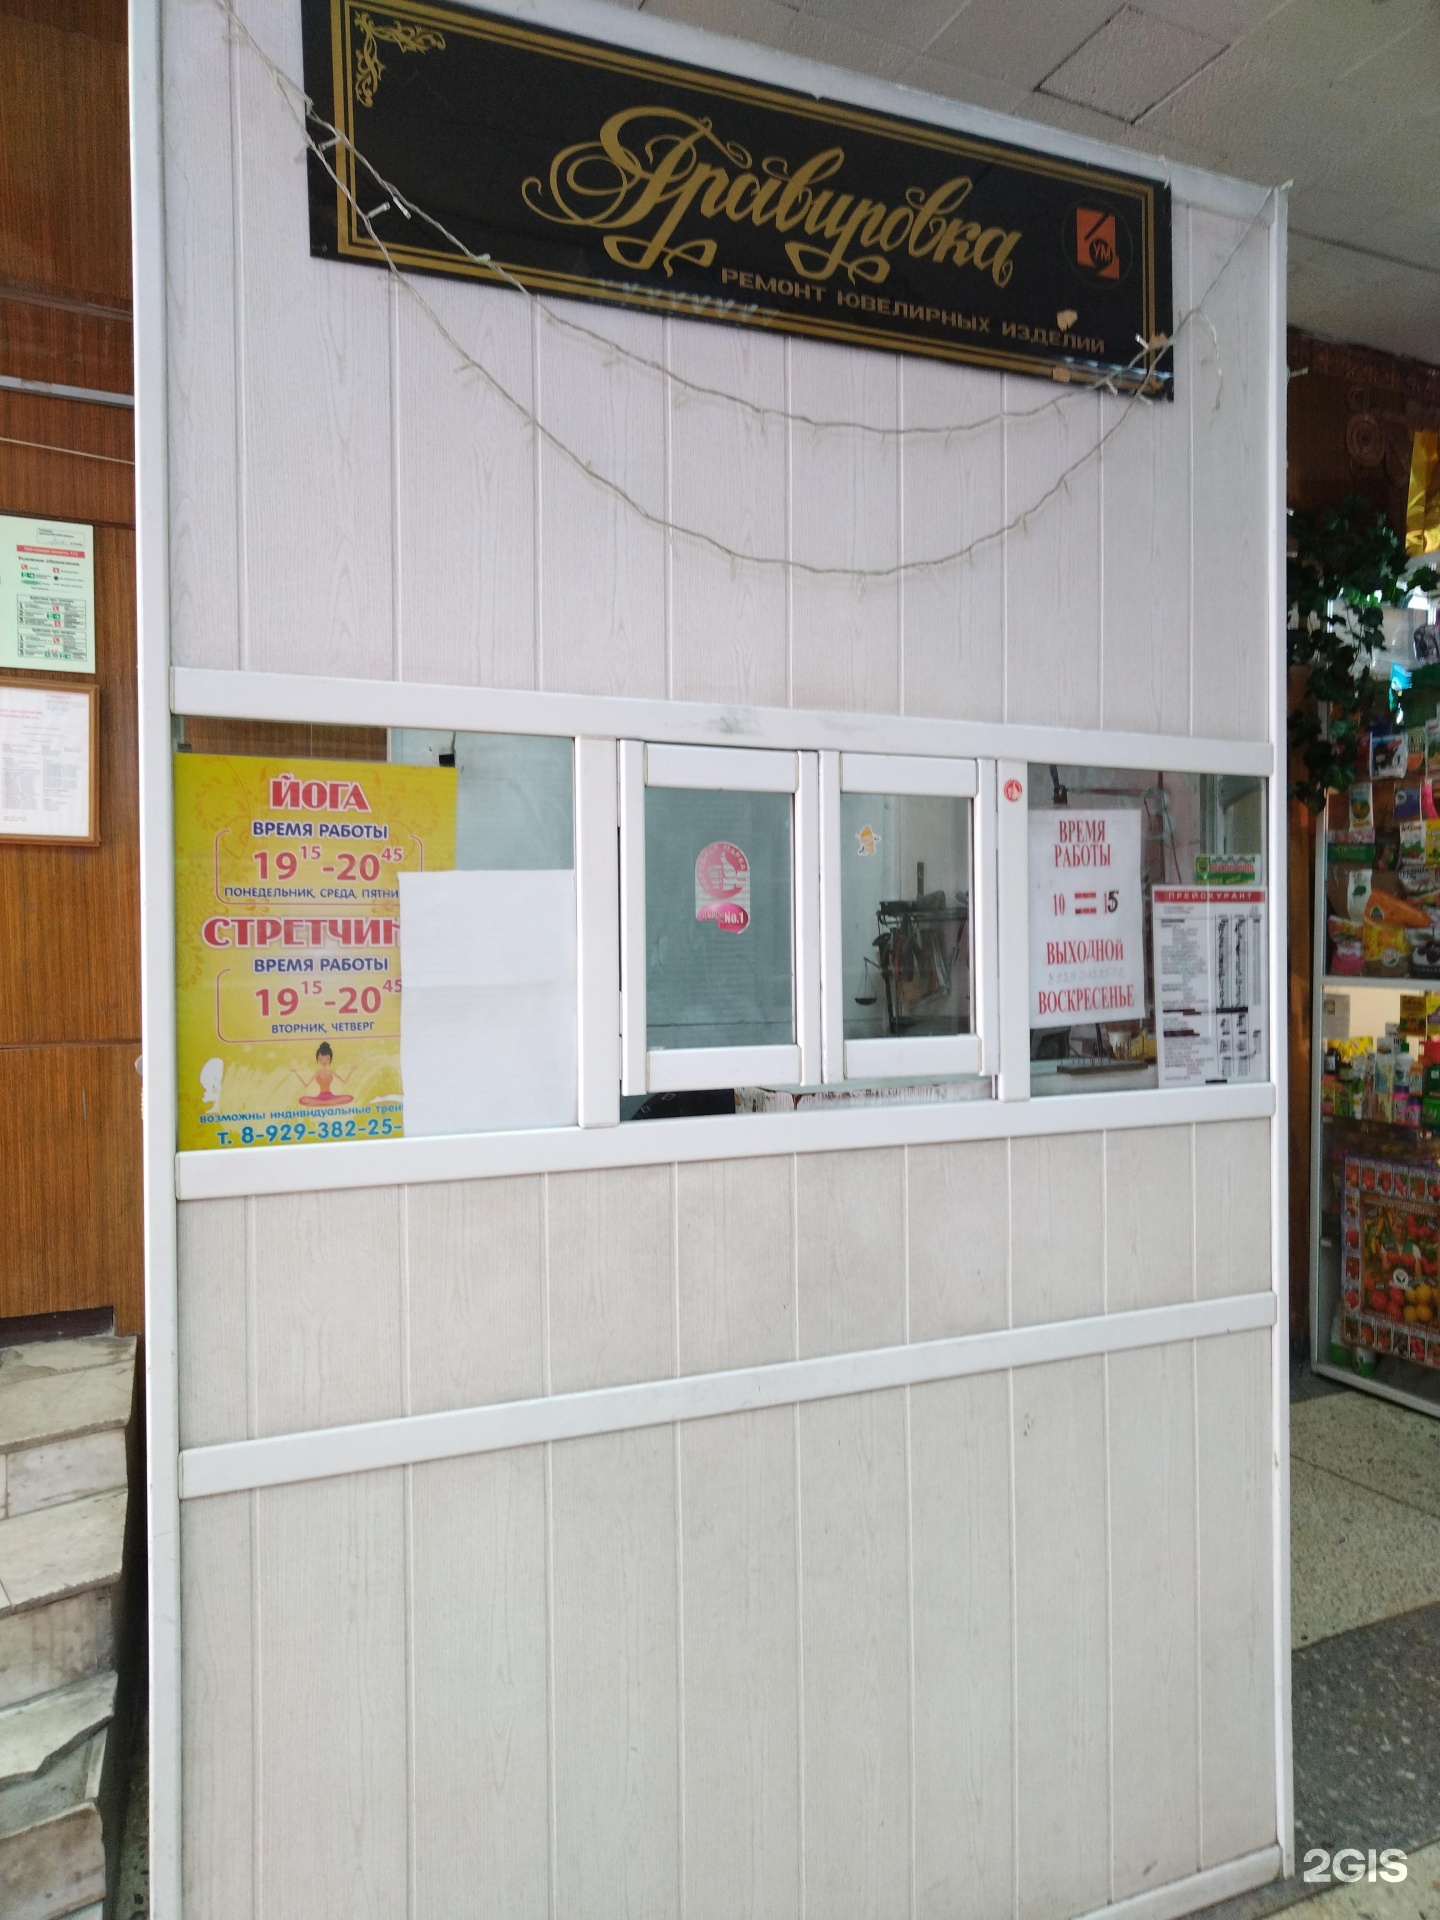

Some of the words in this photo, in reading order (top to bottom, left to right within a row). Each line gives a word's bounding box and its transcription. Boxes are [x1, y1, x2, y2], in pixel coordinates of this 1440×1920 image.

[720, 268, 827, 303] РЕМОНТ
[837, 290, 991, 333] ЮВЕЛИРНЫХ
[1001, 321, 1105, 353] ИЗДЕЛИЙ
[271, 775, 370, 811] ЙОГА
[253, 821, 313, 838] ВРЕМЯ
[319, 823, 388, 840] РАБОТЫ
[1058, 819, 1106, 842] ВРЕМЯ
[1054, 844, 1111, 867] РАБОТЫ
[224, 887, 315, 899] ПОНЕДЕЛЬНИК,
[320, 888, 358, 900] СРЕДА,
[1053, 893, 1066, 916] 10
[1168, 891, 1252, 901] ПРЕЙСКУРАНТ
[1046, 938, 1124, 965] ВЫХОДНОЙ
[254, 958, 314, 972] ВРЕМЯ
[320, 957, 388, 972] РАБОТЫ
[1038, 984, 1135, 1015] ВОСКРЕСЕНЬЕ
[271, 1023, 328, 1034] ВТОРНИК,
[332, 1021, 375, 1032] ЧЕТВЕРГ
[200, 1111, 265, 1123] возможны
[270, 1106, 371, 1120] индивидуальные
[376, 1104, 404, 1117] трен
